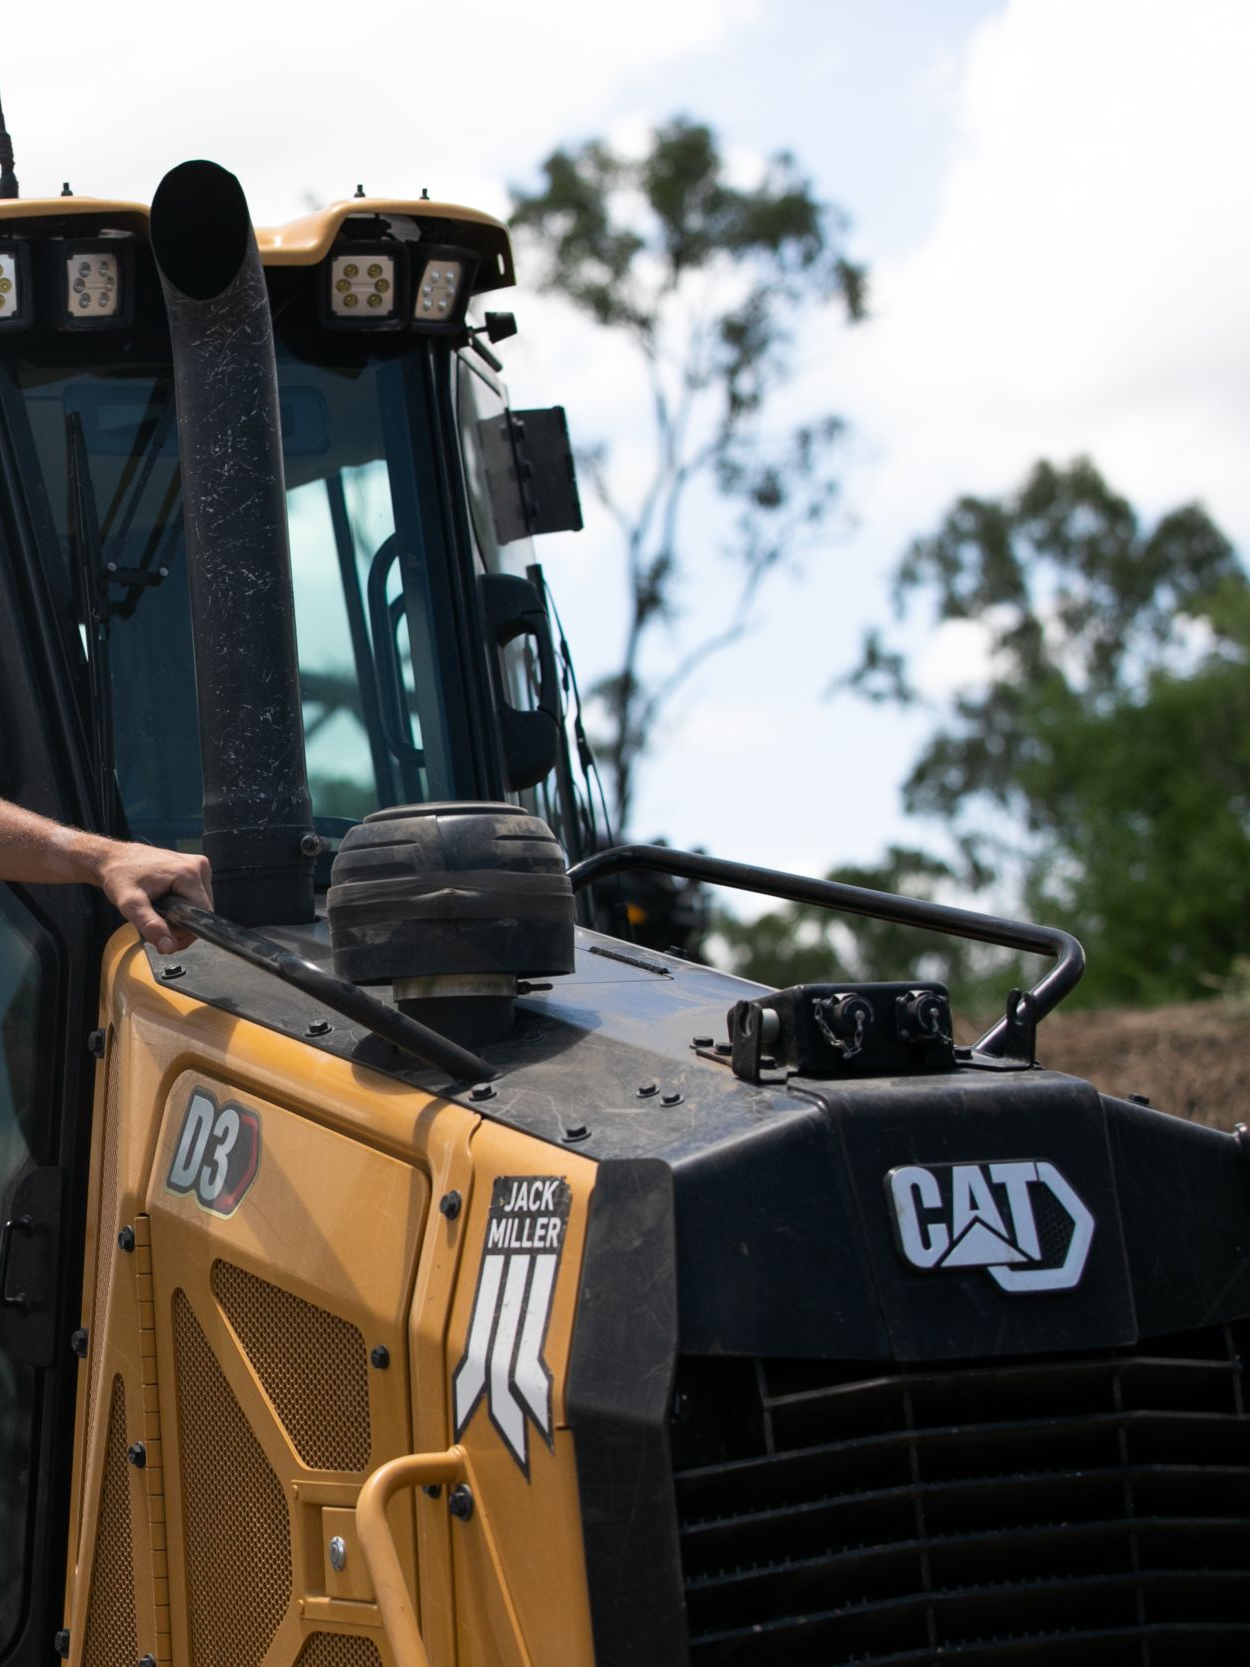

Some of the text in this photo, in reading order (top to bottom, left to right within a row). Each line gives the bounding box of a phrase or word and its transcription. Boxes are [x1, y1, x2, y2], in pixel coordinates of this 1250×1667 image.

[169, 1094, 240, 1201] D3
[503, 1180, 559, 1213] JACK
[890, 1161, 1043, 1269] CAT
[487, 1217, 562, 1249] MILLER
